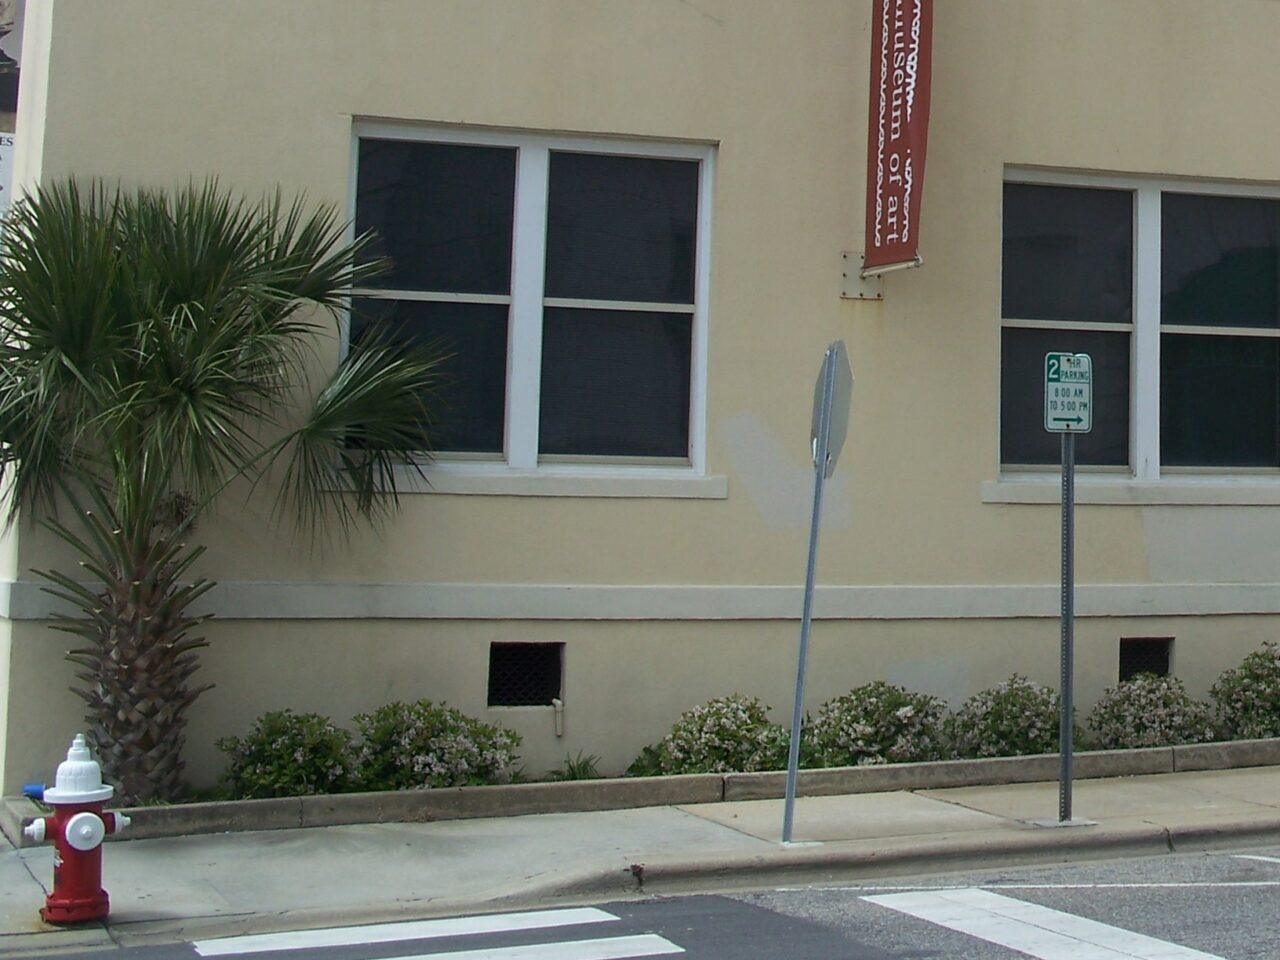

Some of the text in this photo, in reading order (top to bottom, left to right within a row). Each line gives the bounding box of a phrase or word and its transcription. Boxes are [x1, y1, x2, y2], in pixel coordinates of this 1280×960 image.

[889, 153, 902, 186] of
[886, 195, 900, 245] art
[1049, 359, 1059, 379] 2
[1060, 370, 1089, 381] PARKING
[1073, 388, 1084, 398] AM
[1050, 400, 1058, 411] TO
[1079, 401, 1088, 411] PM
